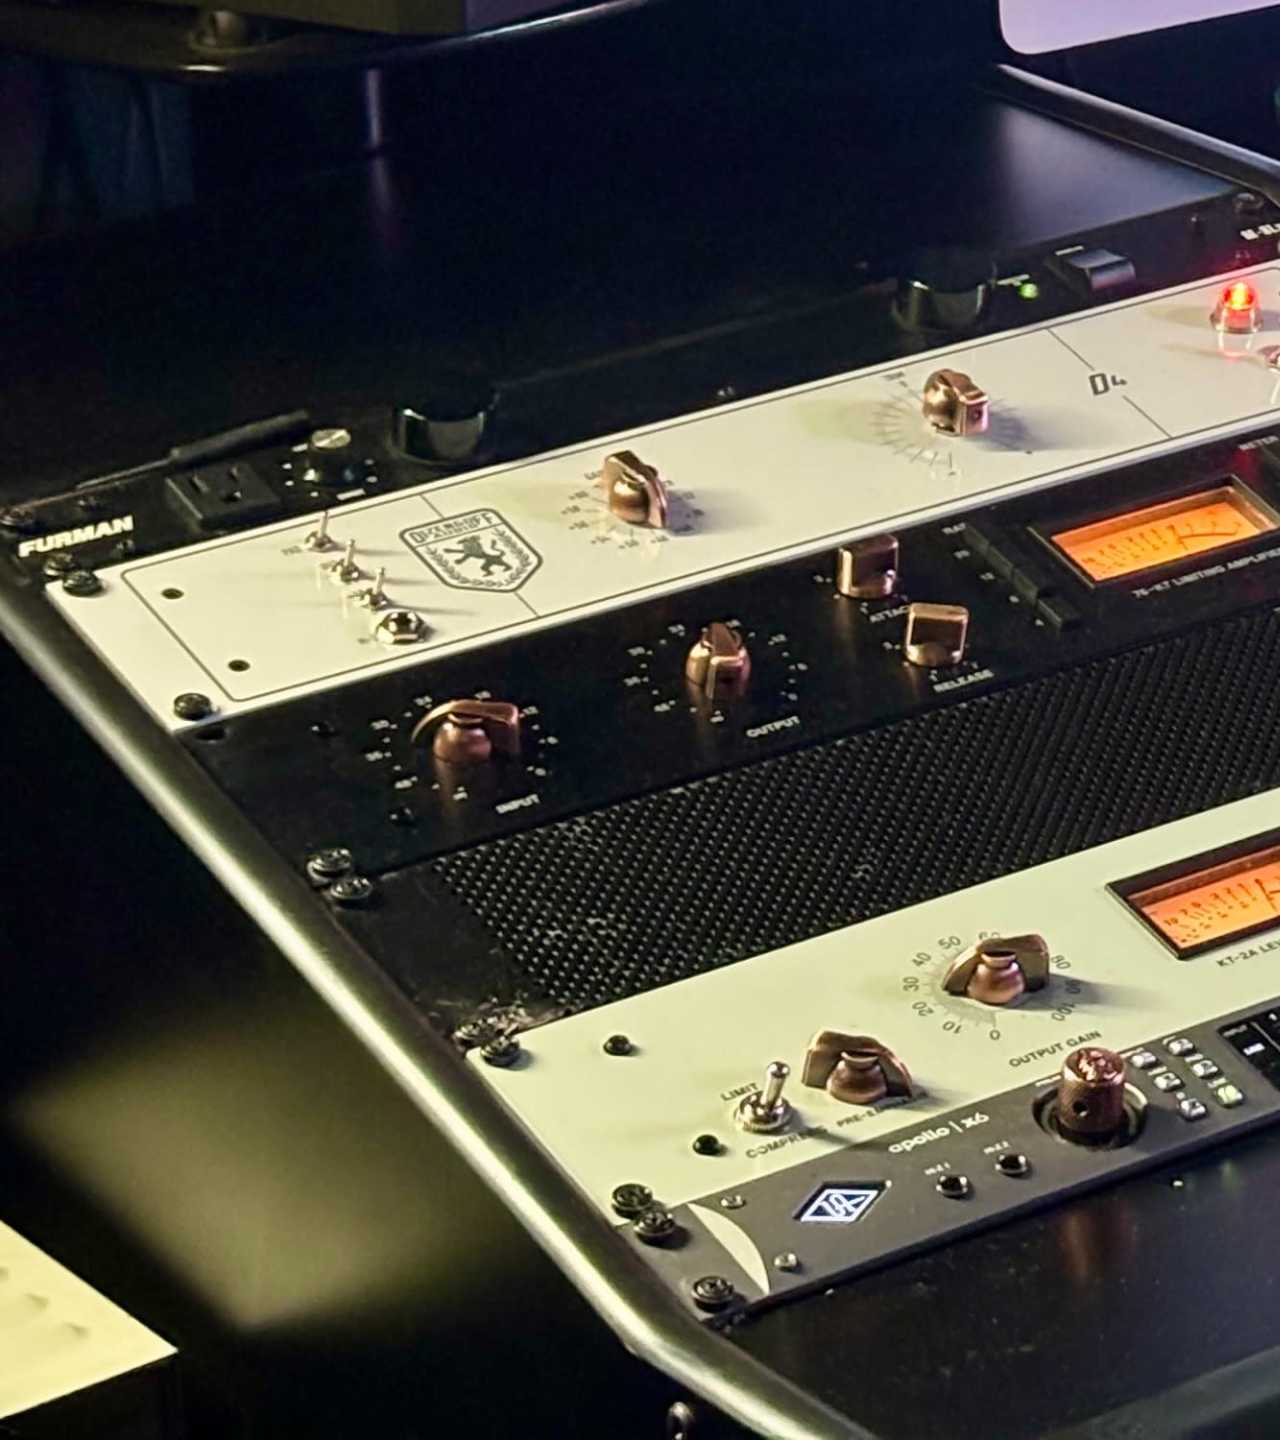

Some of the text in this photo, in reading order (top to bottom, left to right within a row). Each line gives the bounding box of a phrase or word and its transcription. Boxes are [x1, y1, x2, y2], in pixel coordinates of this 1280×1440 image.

[18, 514, 134, 558] FURMAN
[746, 715, 801, 739] OUTPUT
[938, 935, 962, 950] 50
[911, 951, 932, 967] 40
[1216, 948, 1258, 968] KT-2A
[903, 976, 919, 992] 30
[912, 1001, 935, 1017] 20
[1051, 1001, 1076, 1022] 100
[942, 1020, 962, 1035] 10
[989, 1029, 1001, 1041] 0
[1008, 1030, 1102, 1068] OUTPUT GAIN
[720, 1081, 759, 1101] LIMIT
[888, 1125, 949, 1154] apollo
[961, 1111, 990, 1129] x6
